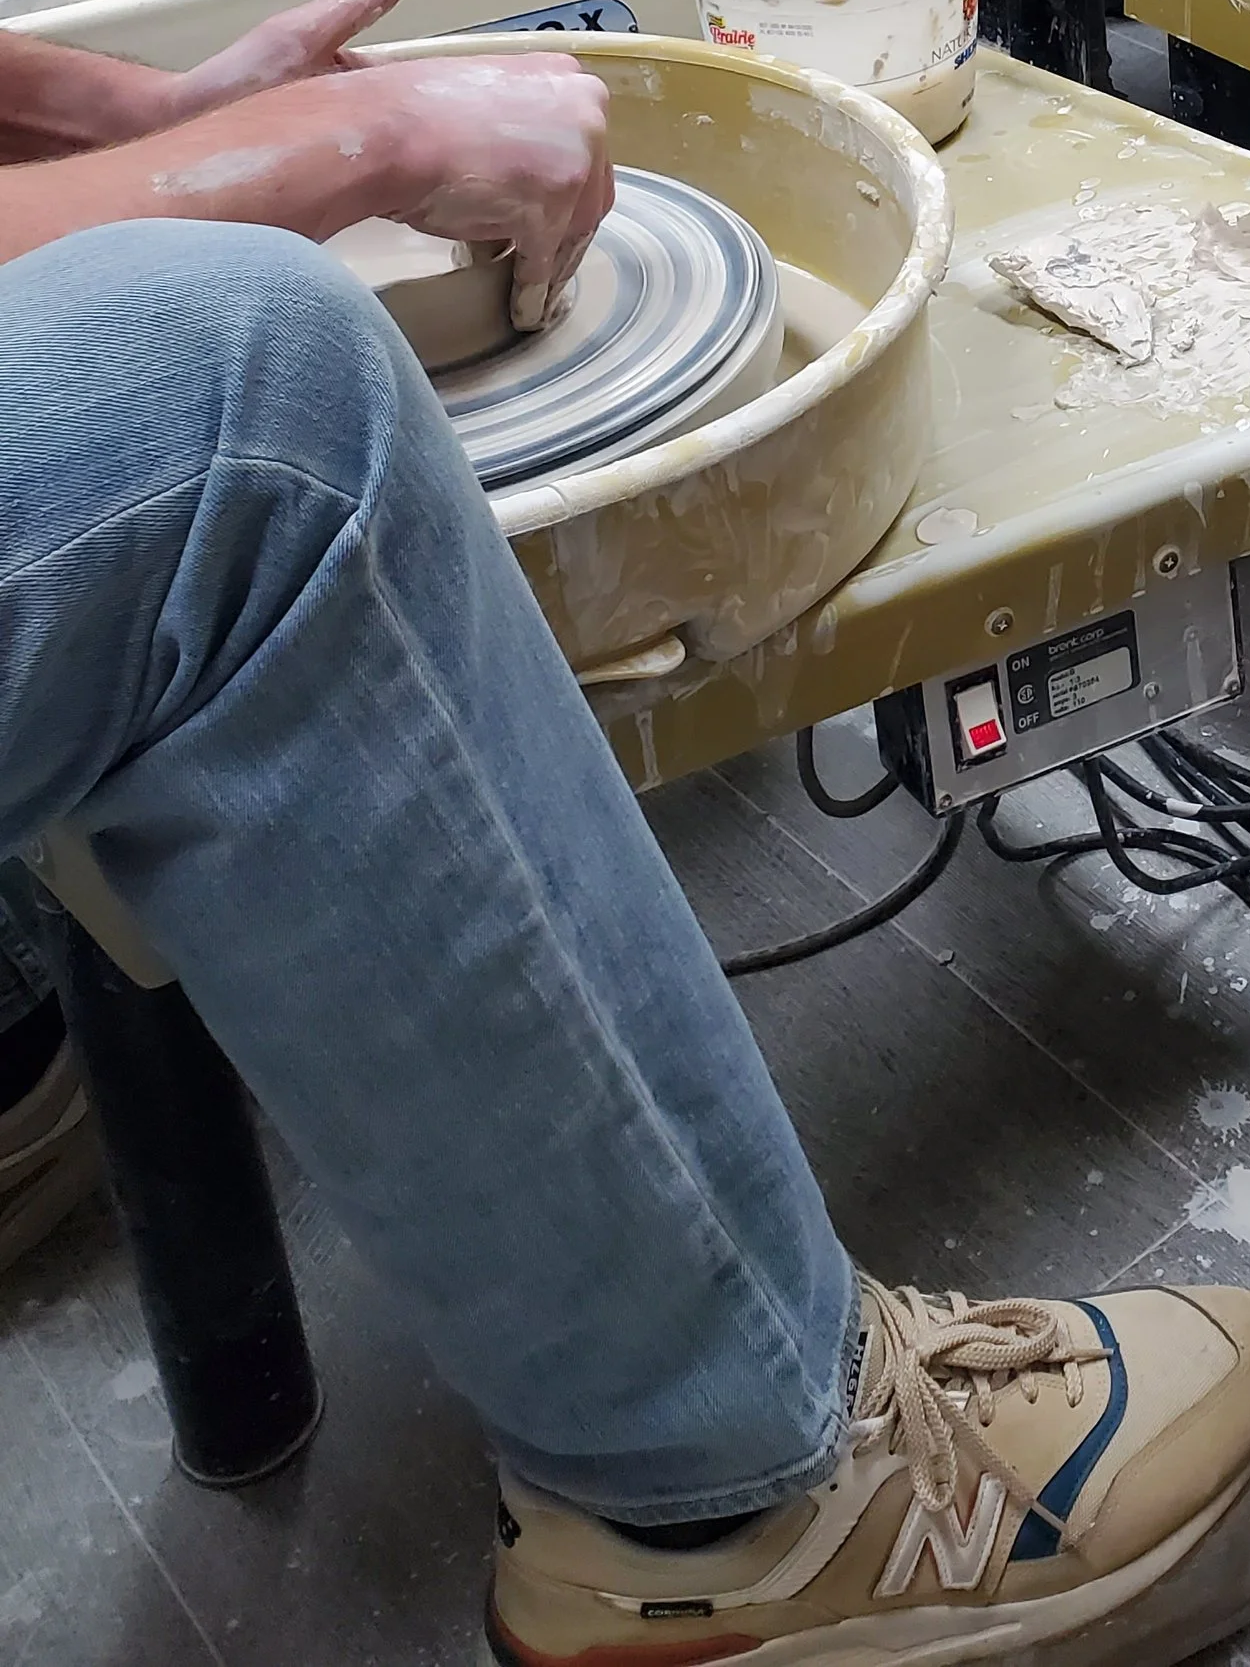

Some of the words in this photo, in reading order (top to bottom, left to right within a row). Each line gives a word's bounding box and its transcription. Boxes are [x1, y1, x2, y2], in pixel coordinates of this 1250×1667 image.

[709, 25, 756, 45] Prairie
[1047, 636, 1079, 655] brent
[1079, 627, 1105, 643] corp
[1011, 655, 1031, 672] ON
[1018, 712, 1040, 729] OFF
[873, 1470, 1009, 1601] N
